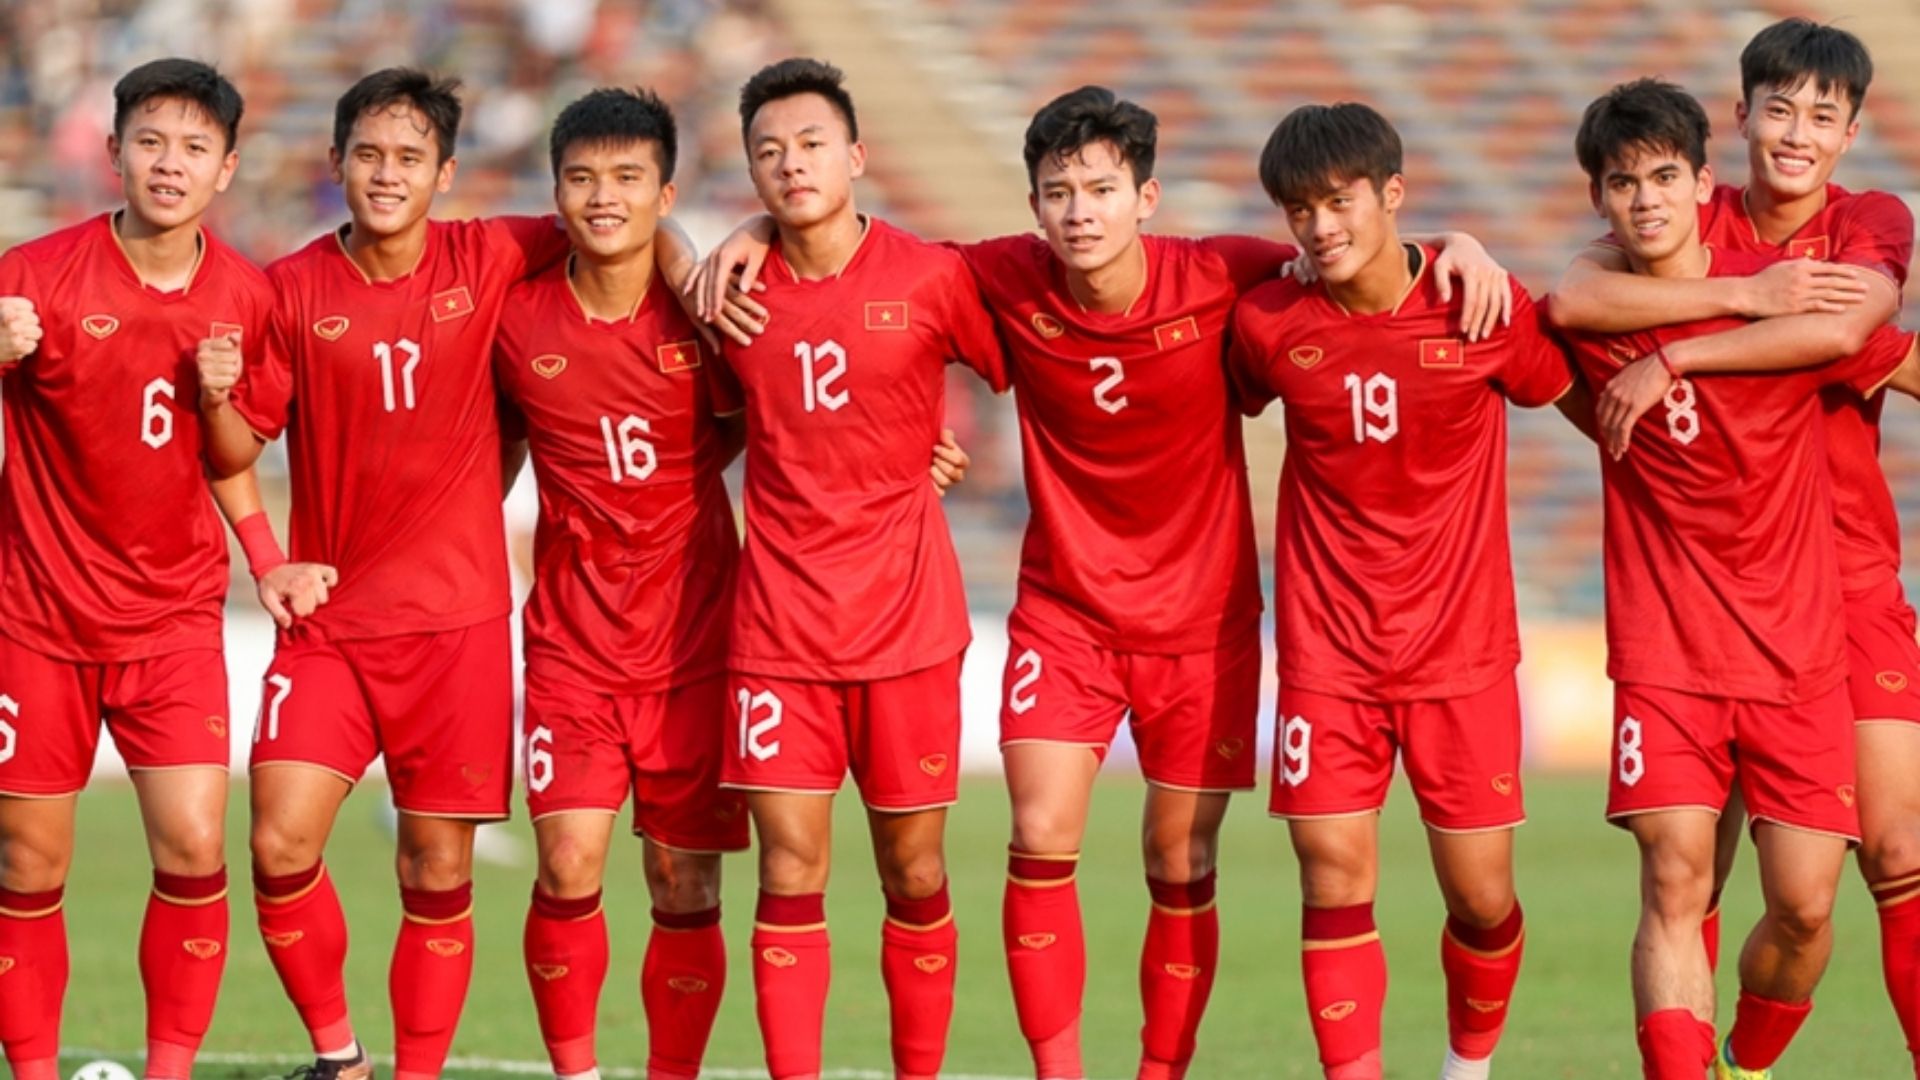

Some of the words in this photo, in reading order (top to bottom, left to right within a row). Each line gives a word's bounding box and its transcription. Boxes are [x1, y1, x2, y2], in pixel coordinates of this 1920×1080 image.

[373, 338, 420, 412] 17
[794, 339, 849, 412] 12
[1089, 357, 1128, 414] 2
[1344, 372, 1398, 443] 19
[141, 377, 175, 449] 6
[1663, 379, 1700, 446] 8
[600, 414, 657, 484] 16
[1010, 649, 1042, 714] 2
[523, 725, 554, 793] 6
[737, 687, 783, 762] 12
[1619, 716, 1645, 786] 8
